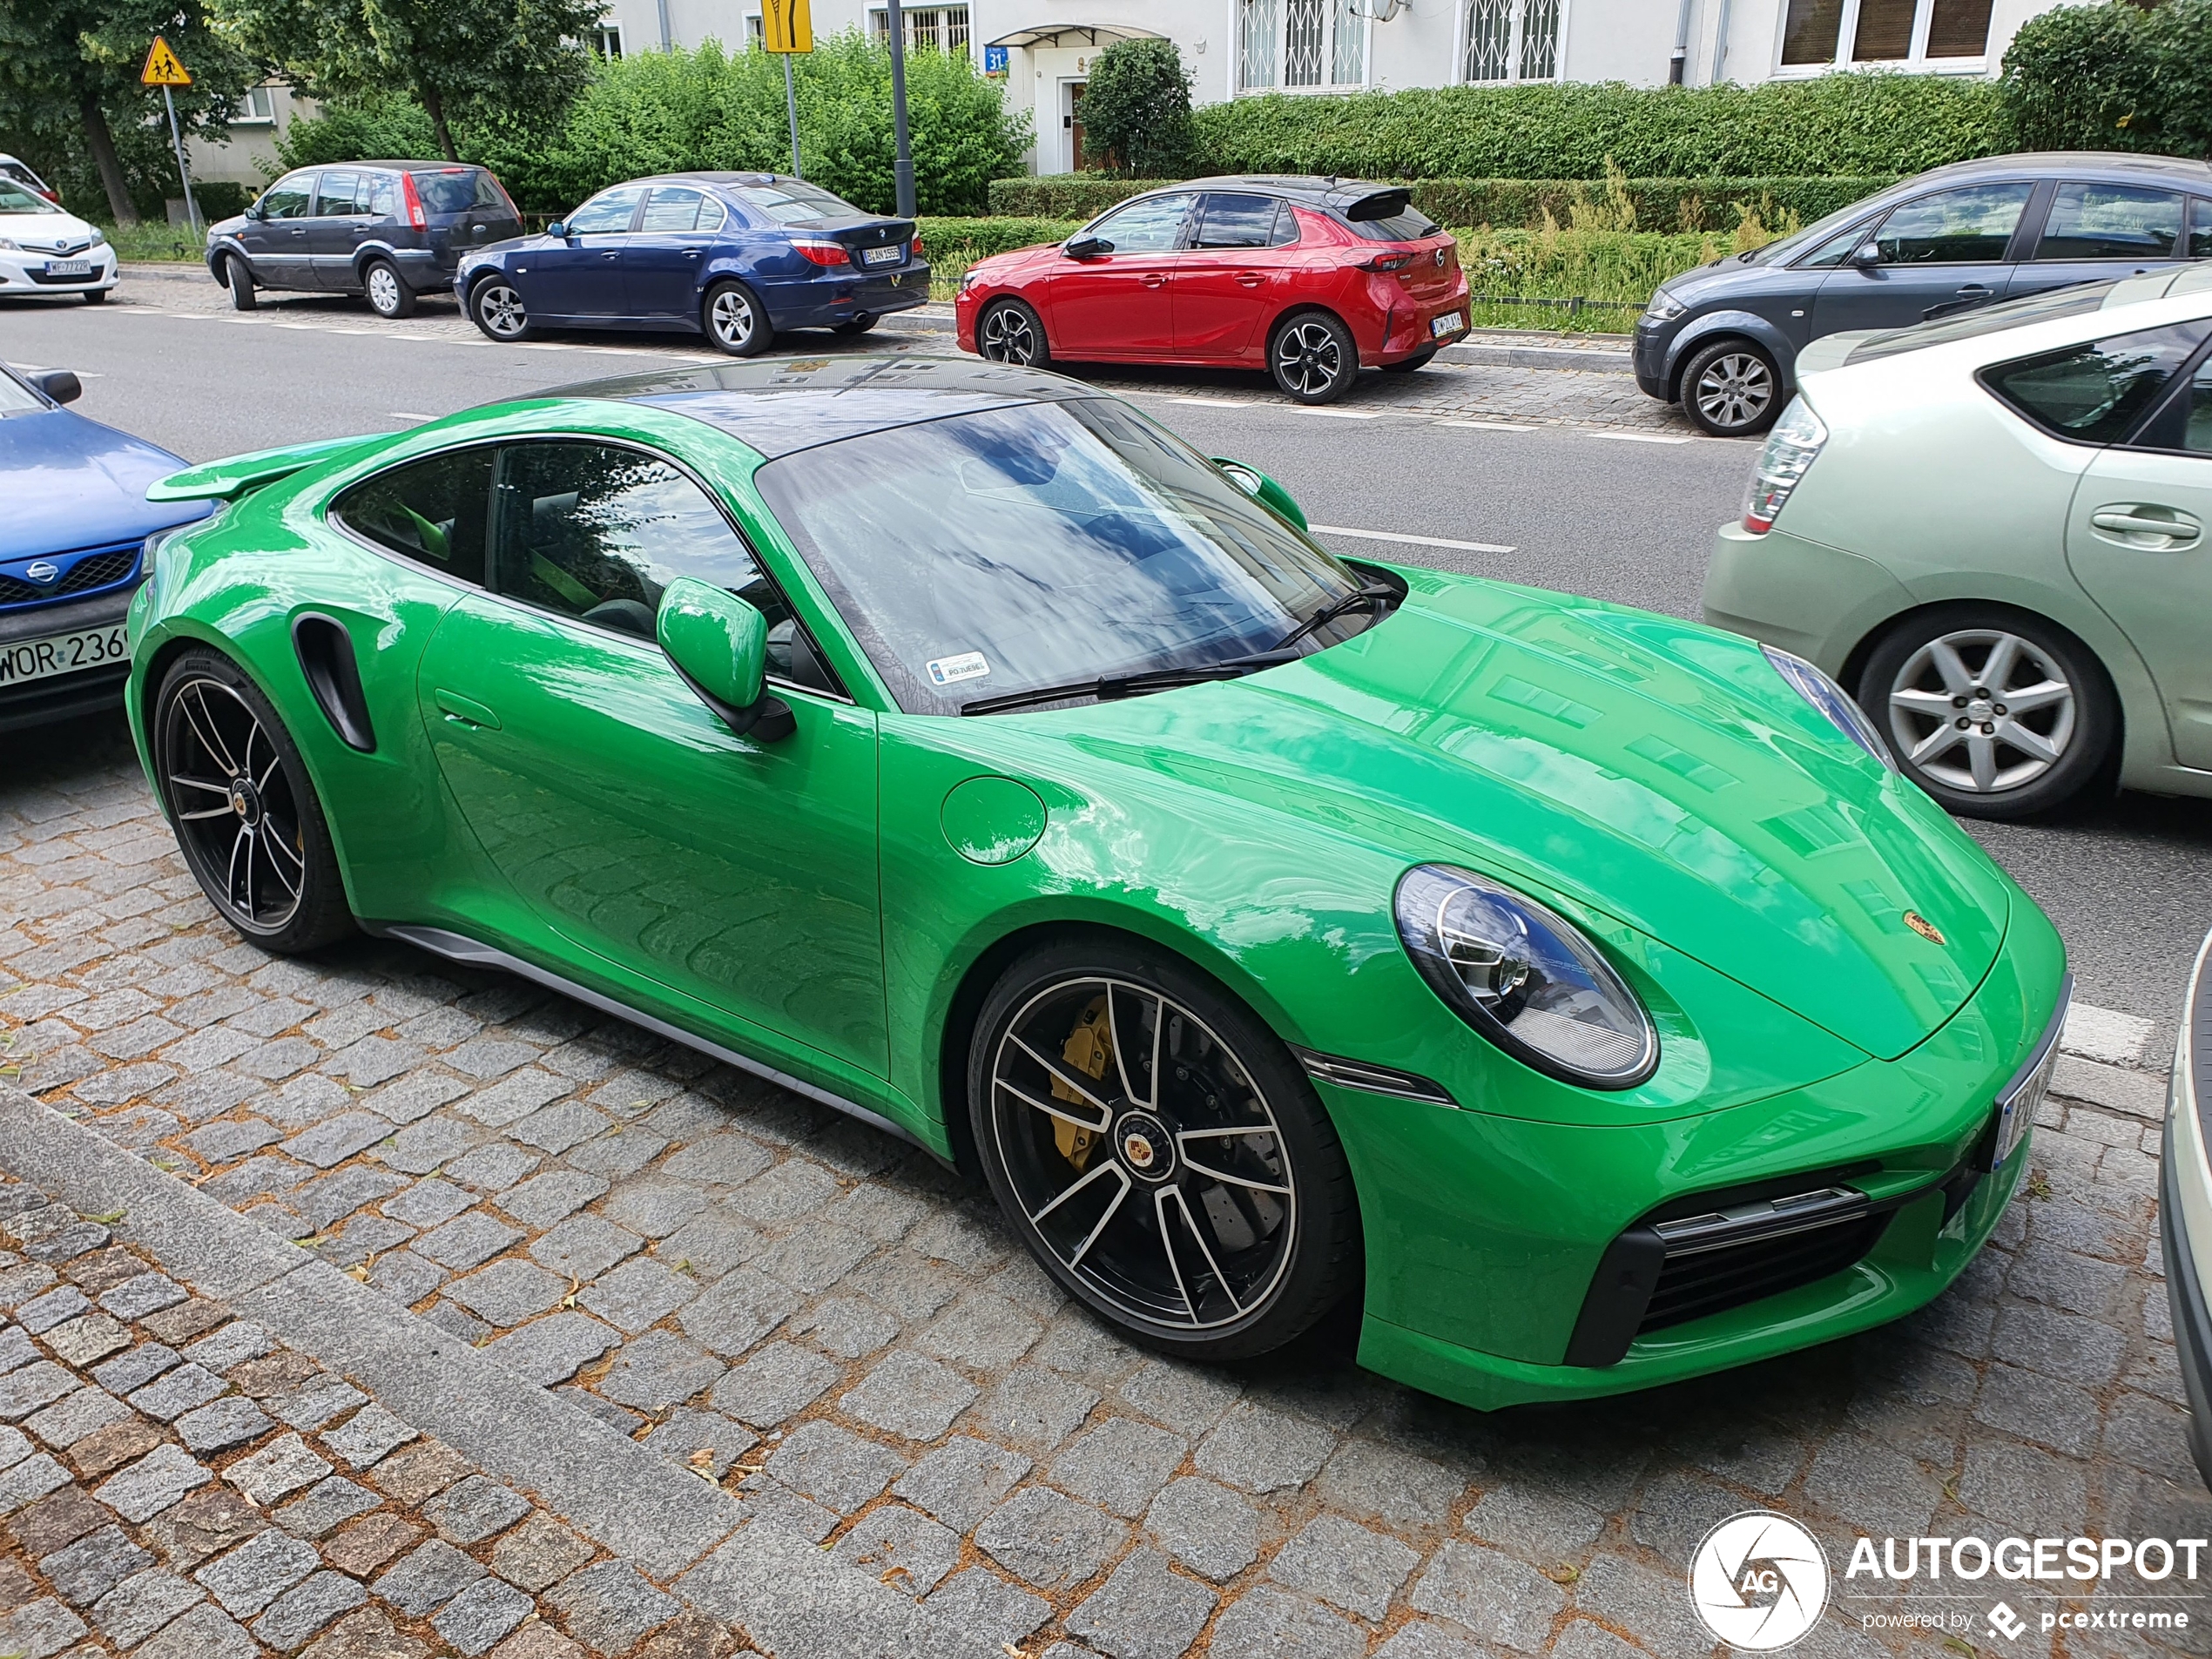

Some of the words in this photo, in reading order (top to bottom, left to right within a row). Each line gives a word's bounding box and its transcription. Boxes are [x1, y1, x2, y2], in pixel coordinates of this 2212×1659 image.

[989, 53, 1001, 70] 31
[867, 251, 873, 261] B
[874, 249, 884, 260] AN
[884, 247, 899, 259] 1555
[1434, 319, 1445, 333] DW
[0, 643, 57, 681] WOR
[66, 628, 131, 667] 236
[948, 668, 959, 677] PO
[960, 664, 981, 674] 7UE96
